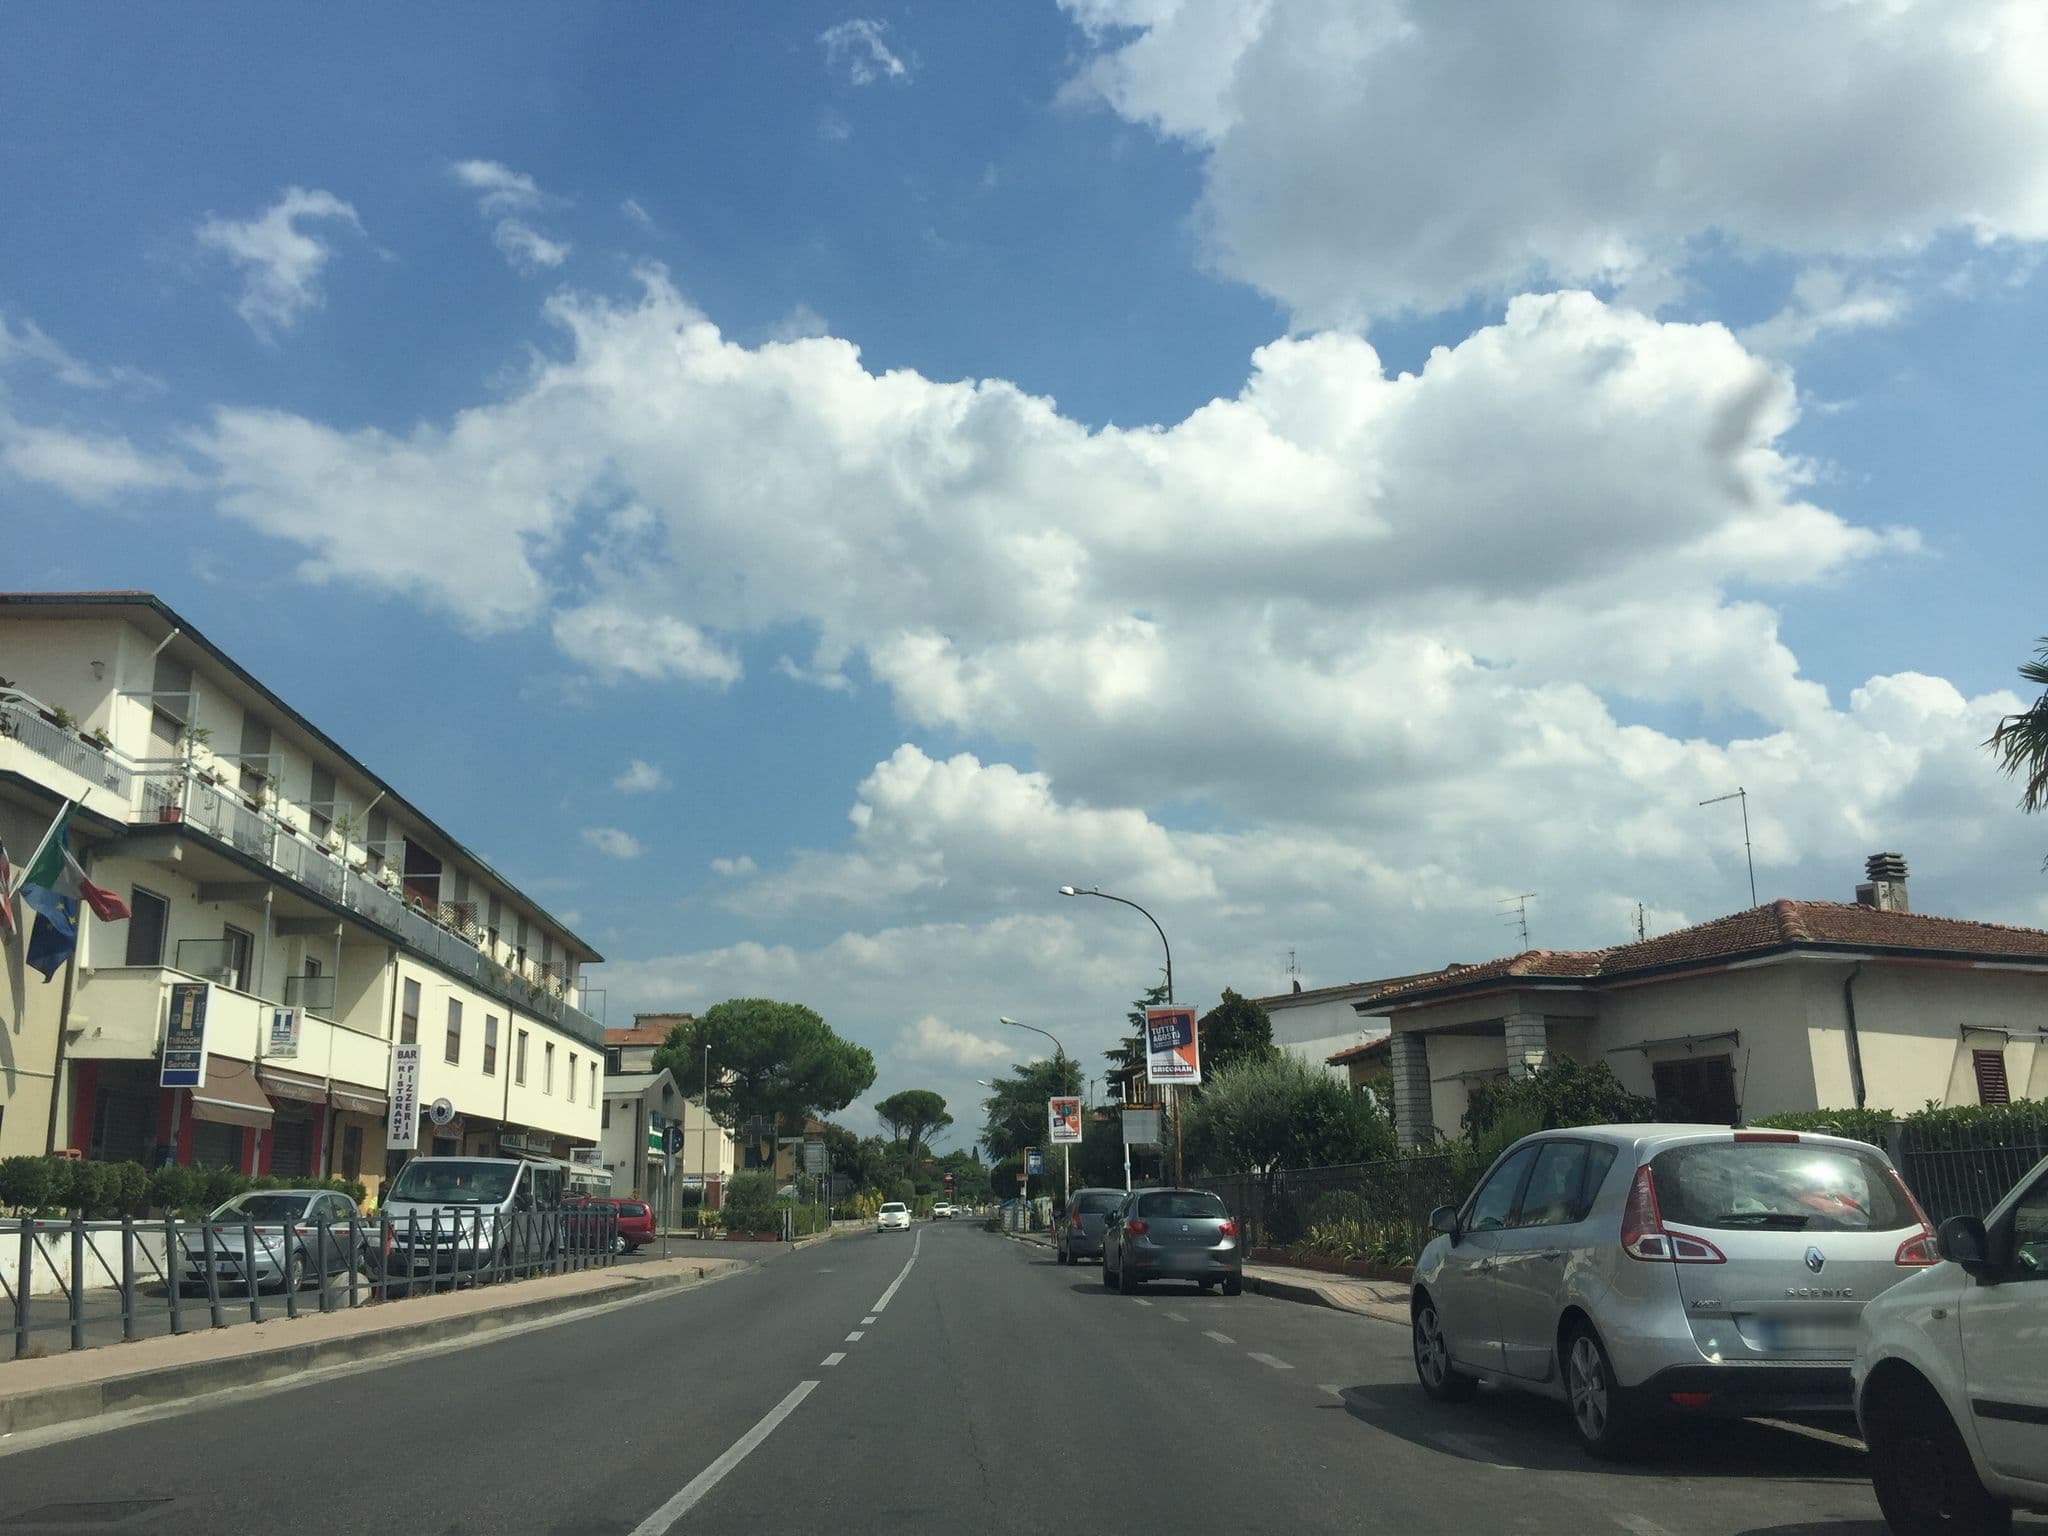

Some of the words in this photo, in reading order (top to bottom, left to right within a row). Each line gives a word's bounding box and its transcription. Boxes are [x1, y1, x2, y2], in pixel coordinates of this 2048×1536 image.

[1151, 1025, 1175, 1035] TUTTO
[1153, 1030, 1181, 1042] AGOSTO
[397, 1050, 417, 1059] BAR
[393, 1066, 405, 1140] RISTORANTE
[402, 1065, 414, 1140] PIZZERIA
[1786, 1287, 1853, 1298] SCENIC
